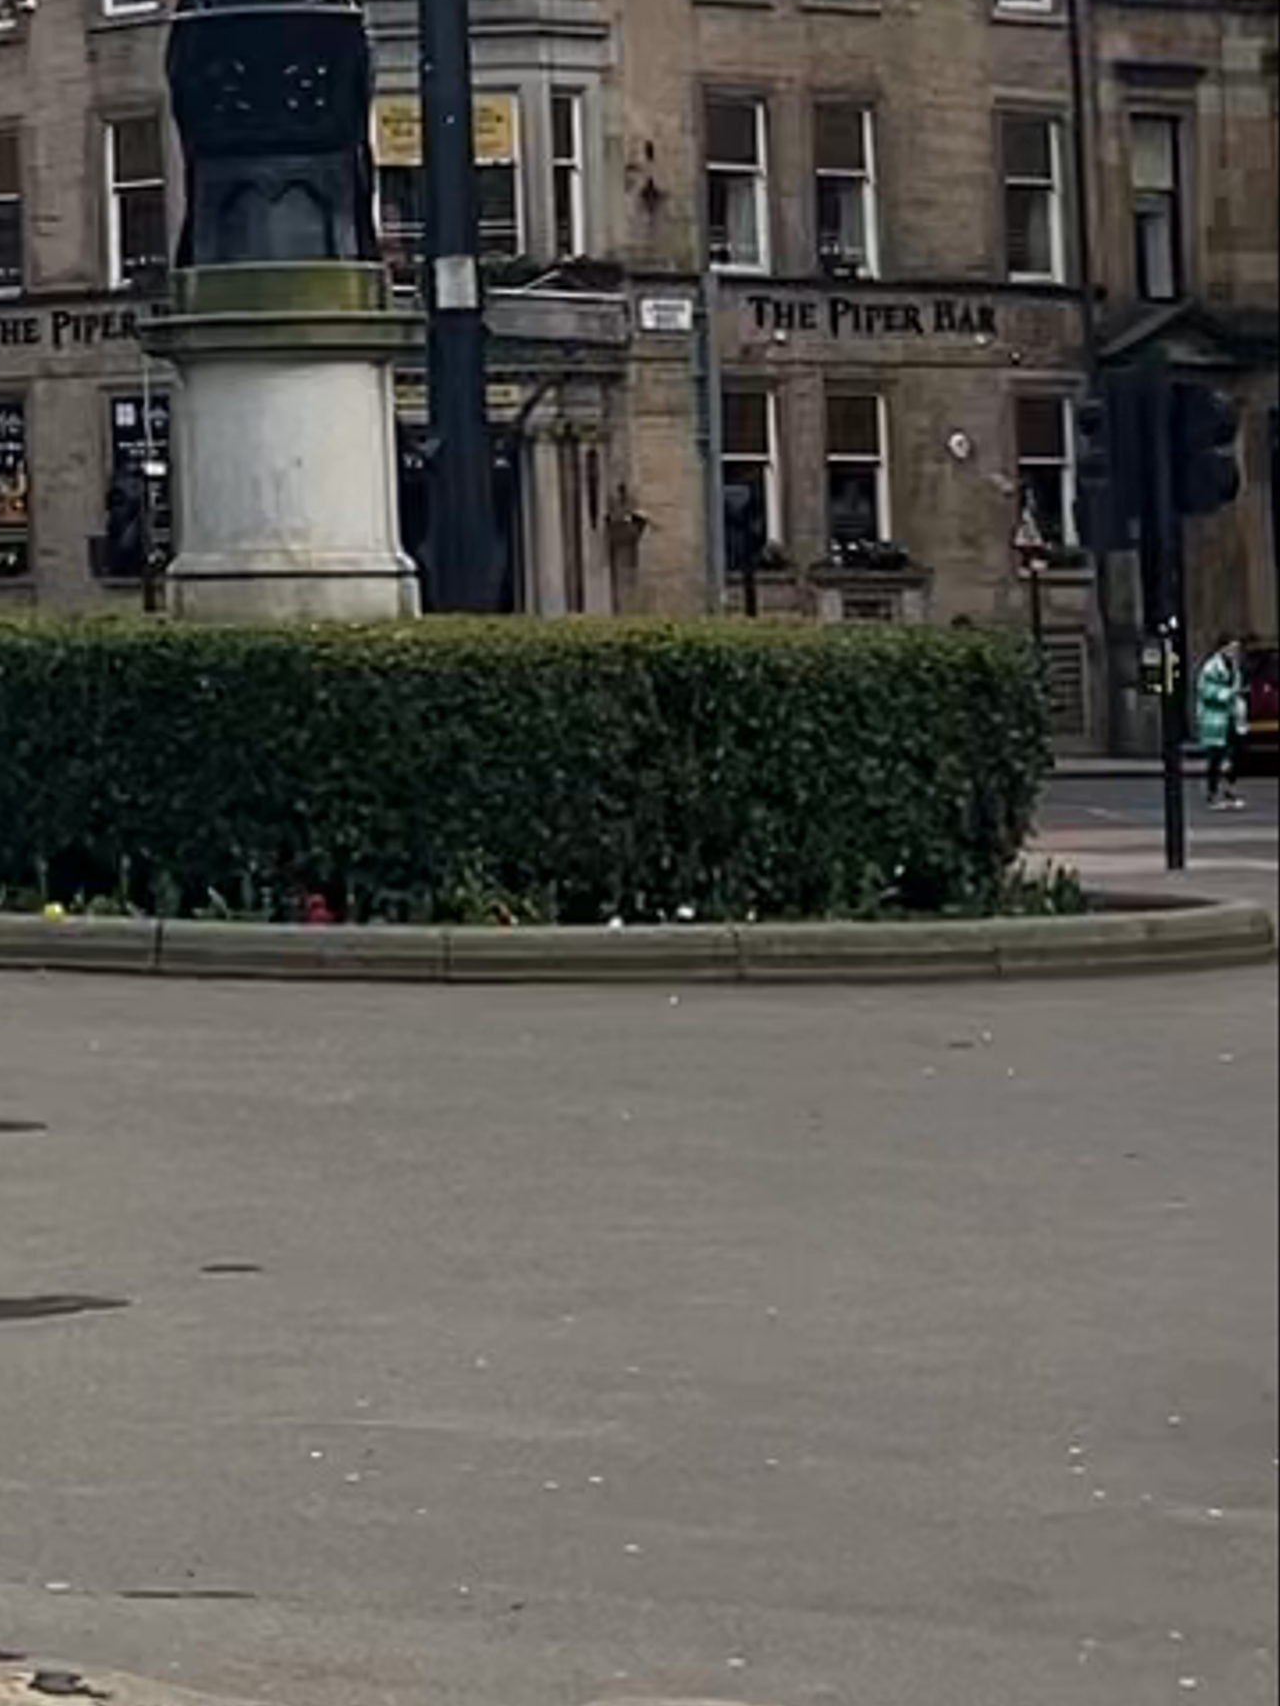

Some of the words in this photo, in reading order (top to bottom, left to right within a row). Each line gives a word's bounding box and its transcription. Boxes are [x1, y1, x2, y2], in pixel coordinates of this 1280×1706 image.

[51, 310, 142, 352] PIPER
[747, 296, 818, 330] THE
[829, 297, 924, 338] PIPER
[934, 300, 998, 333] BAR
